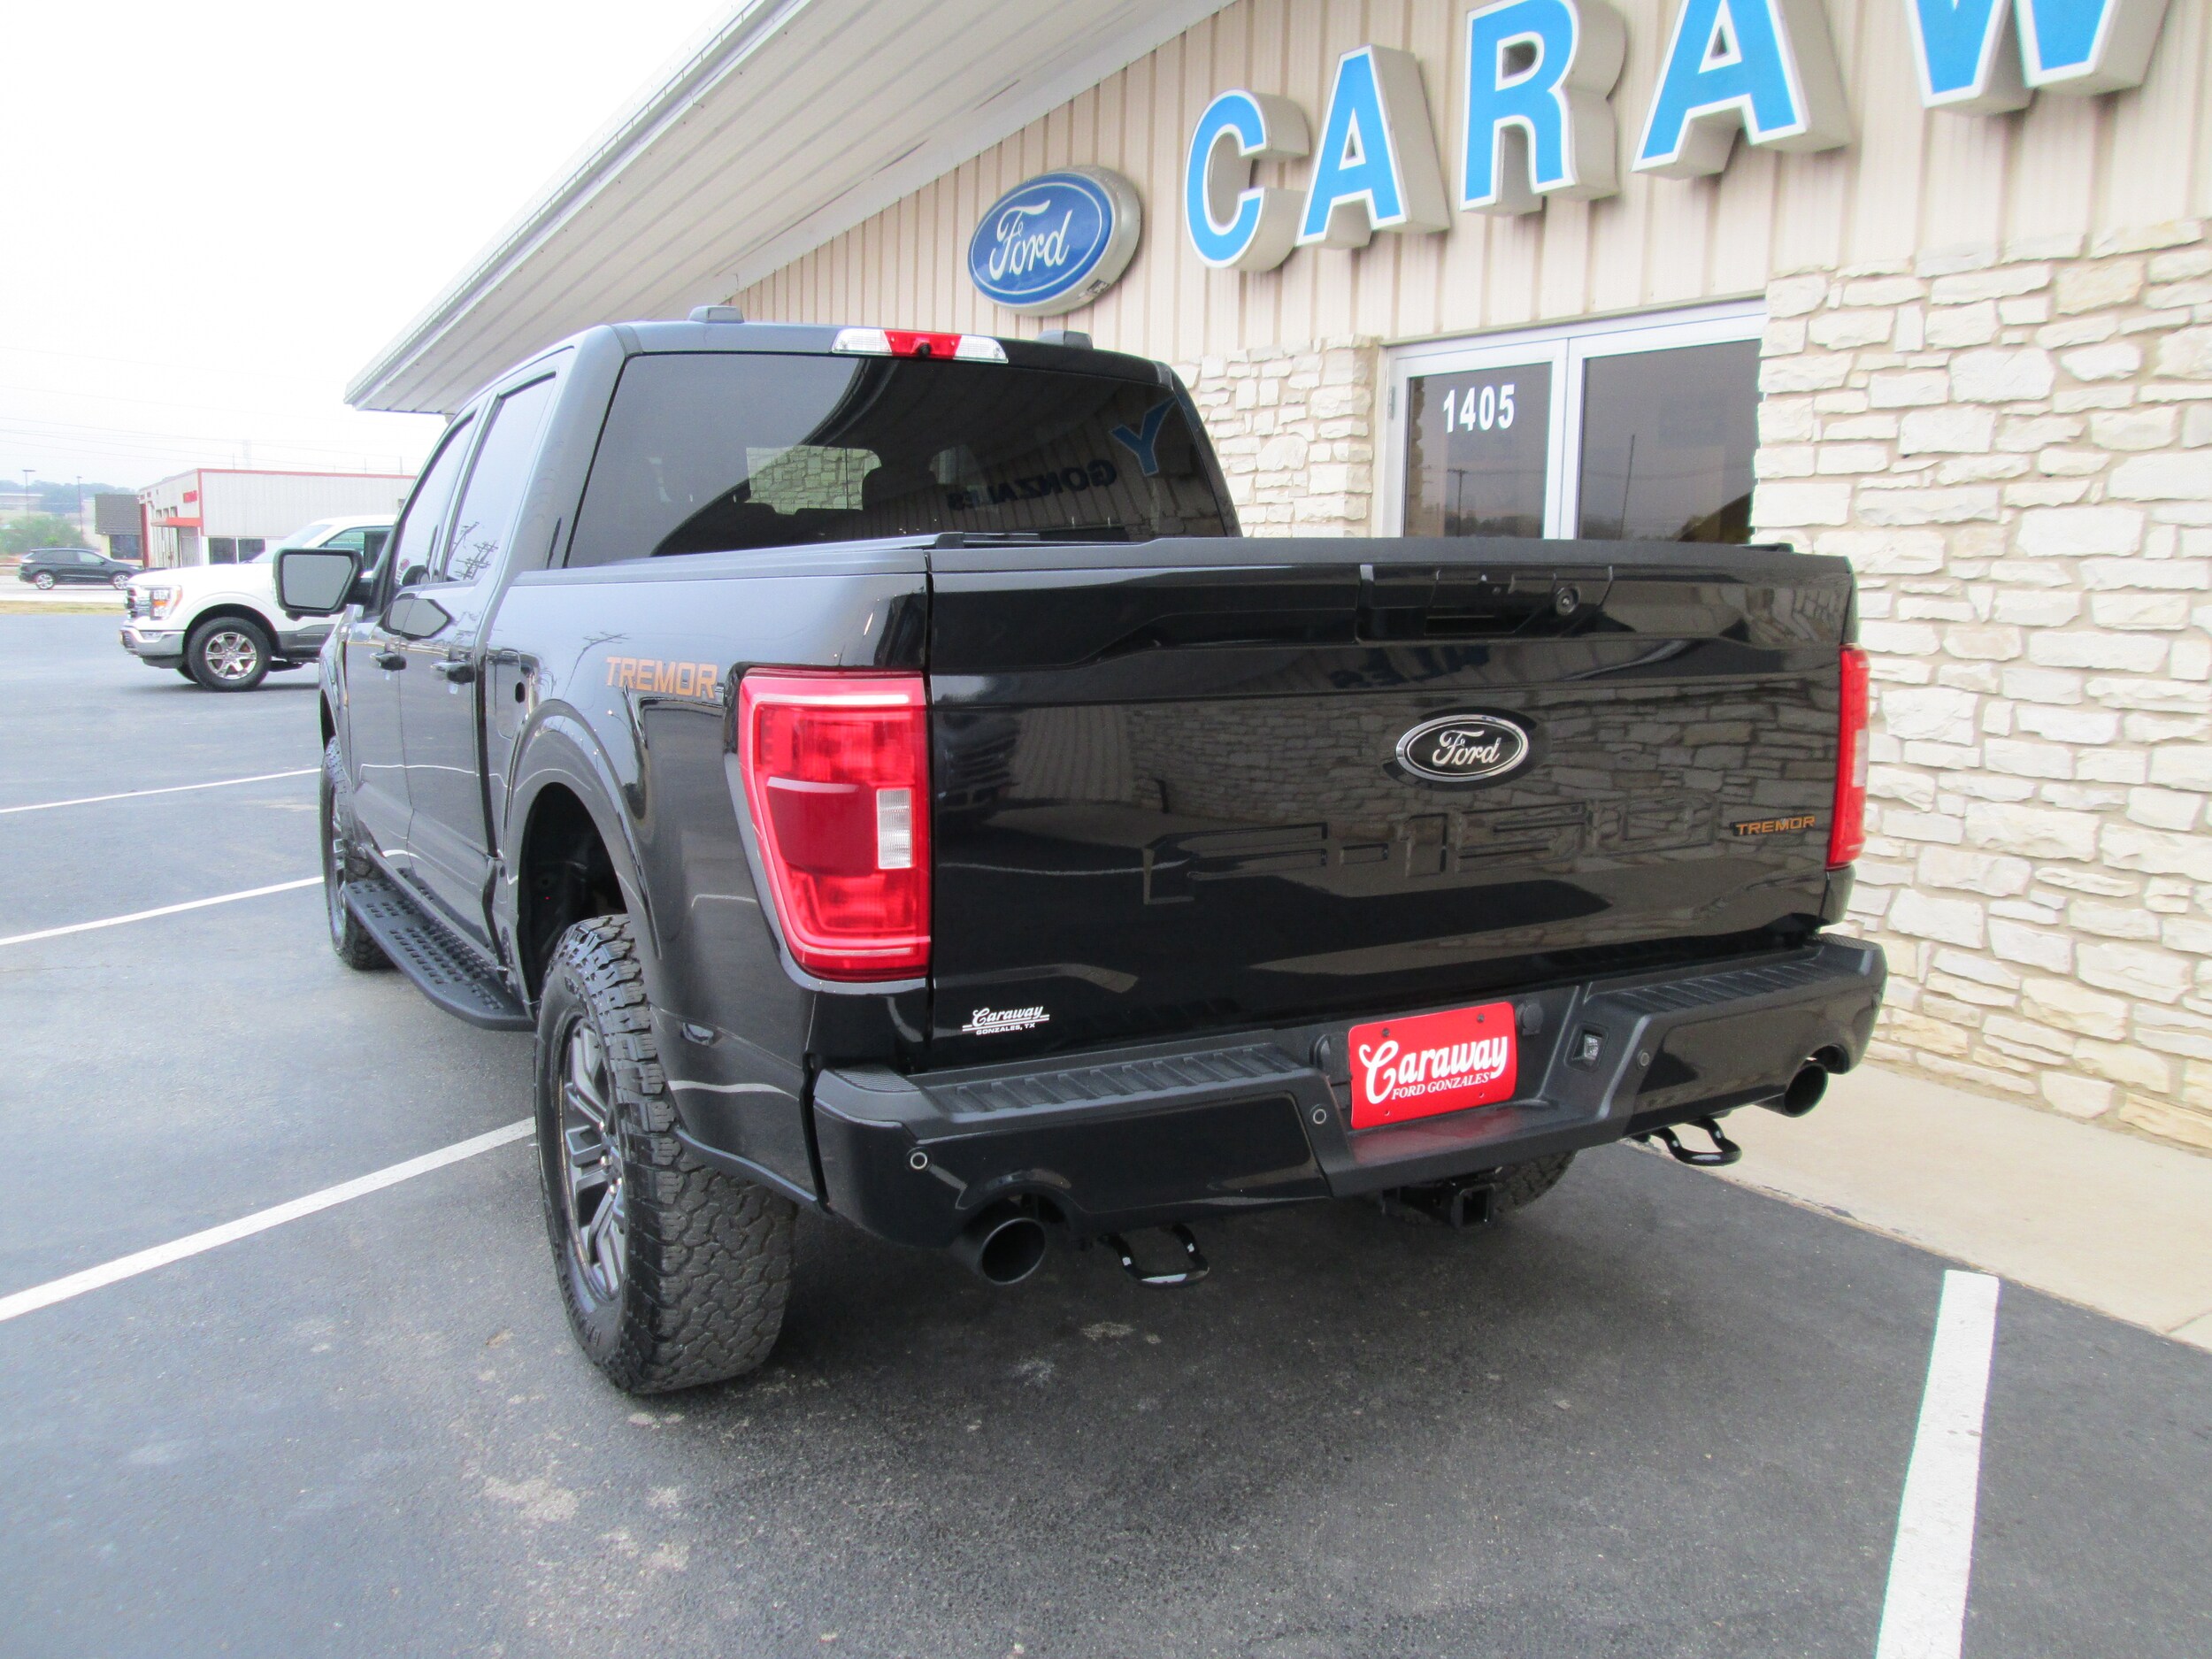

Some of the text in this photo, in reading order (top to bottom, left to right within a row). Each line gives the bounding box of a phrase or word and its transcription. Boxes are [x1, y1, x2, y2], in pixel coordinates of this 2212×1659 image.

[988, 199, 1073, 280] Ford
[1442, 383, 1516, 434] 1405
[606, 657, 718, 699] TREMOR
[1432, 729, 1502, 767] Ford
[1735, 815, 1816, 836] TREMOR
[972, 1005, 1044, 1027] Caraway
[976, 1024, 1023, 1035] GONZALES,
[1358, 1035, 1509, 1104] Caraway
[1391, 1071, 1492, 1101] FORD GONZALES
